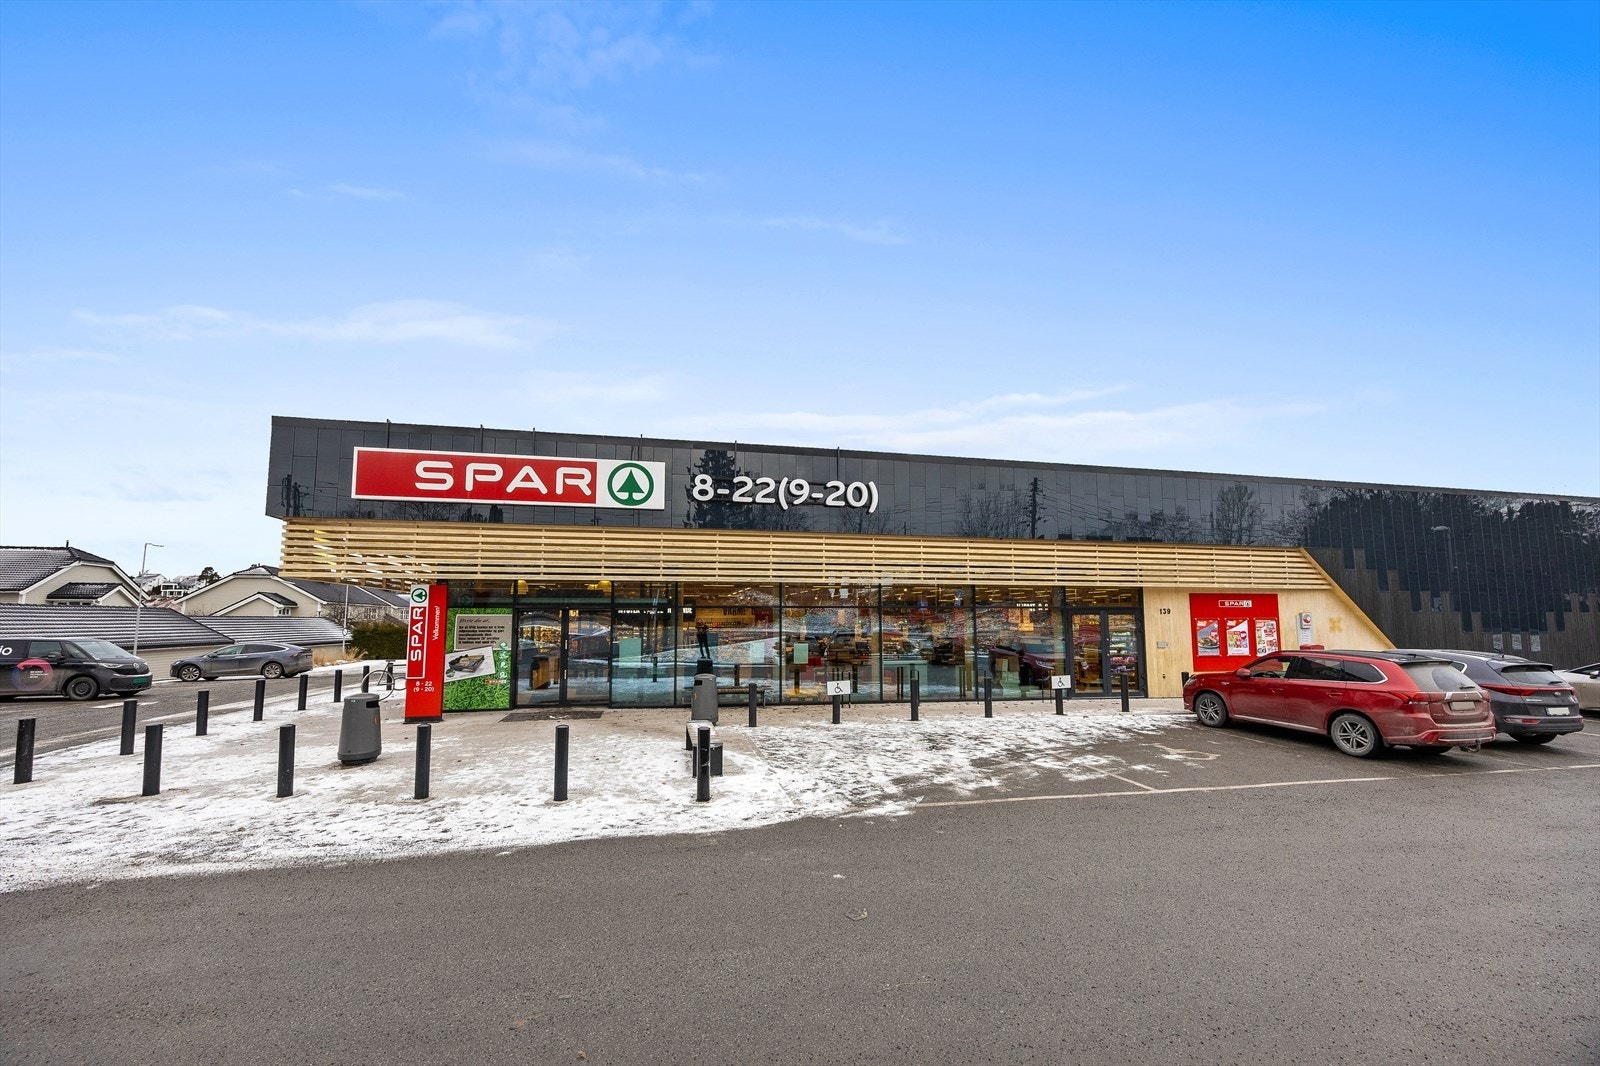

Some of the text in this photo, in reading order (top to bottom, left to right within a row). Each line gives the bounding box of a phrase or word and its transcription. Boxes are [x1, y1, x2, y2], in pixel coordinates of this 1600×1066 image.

[414, 460, 592, 496] SPAR
[692, 474, 879, 514] 8-22(9-20)
[410, 607, 424, 662] SPAR
[432, 605, 441, 641] Velkommen!
